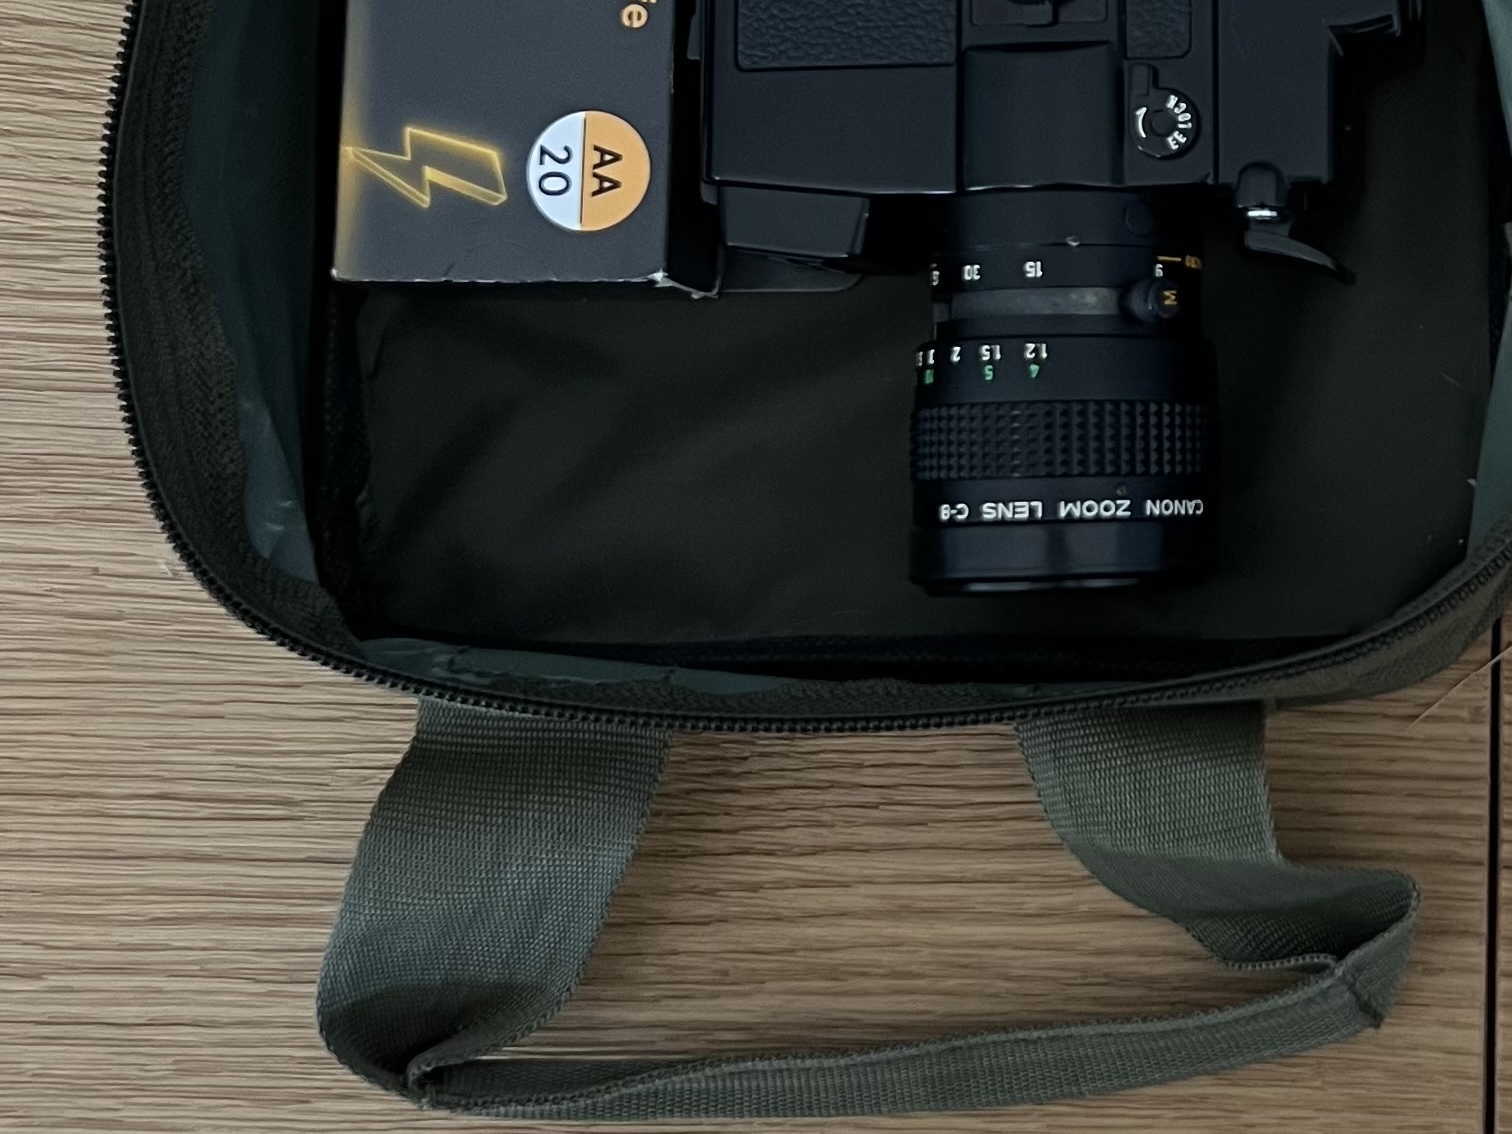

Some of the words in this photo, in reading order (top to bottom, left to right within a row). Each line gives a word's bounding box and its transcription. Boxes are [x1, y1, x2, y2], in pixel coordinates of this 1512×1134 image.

[1166, 130, 1188, 150] EE
[538, 144, 573, 197] 20
[591, 144, 623, 197] AA
[962, 264, 981, 281] 30
[1024, 261, 1043, 278] 15
[950, 346, 962, 363] 2
[980, 344, 1002, 361] 1.5
[1023, 342, 1048, 359] 1.2
[984, 365, 994, 381] 5
[1029, 364, 1040, 379] 4
[939, 503, 970, 522] C-8
[981, 501, 1043, 521] LENS
[1059, 499, 1132, 519] ZOOM
[1145, 499, 1204, 516] CANON
